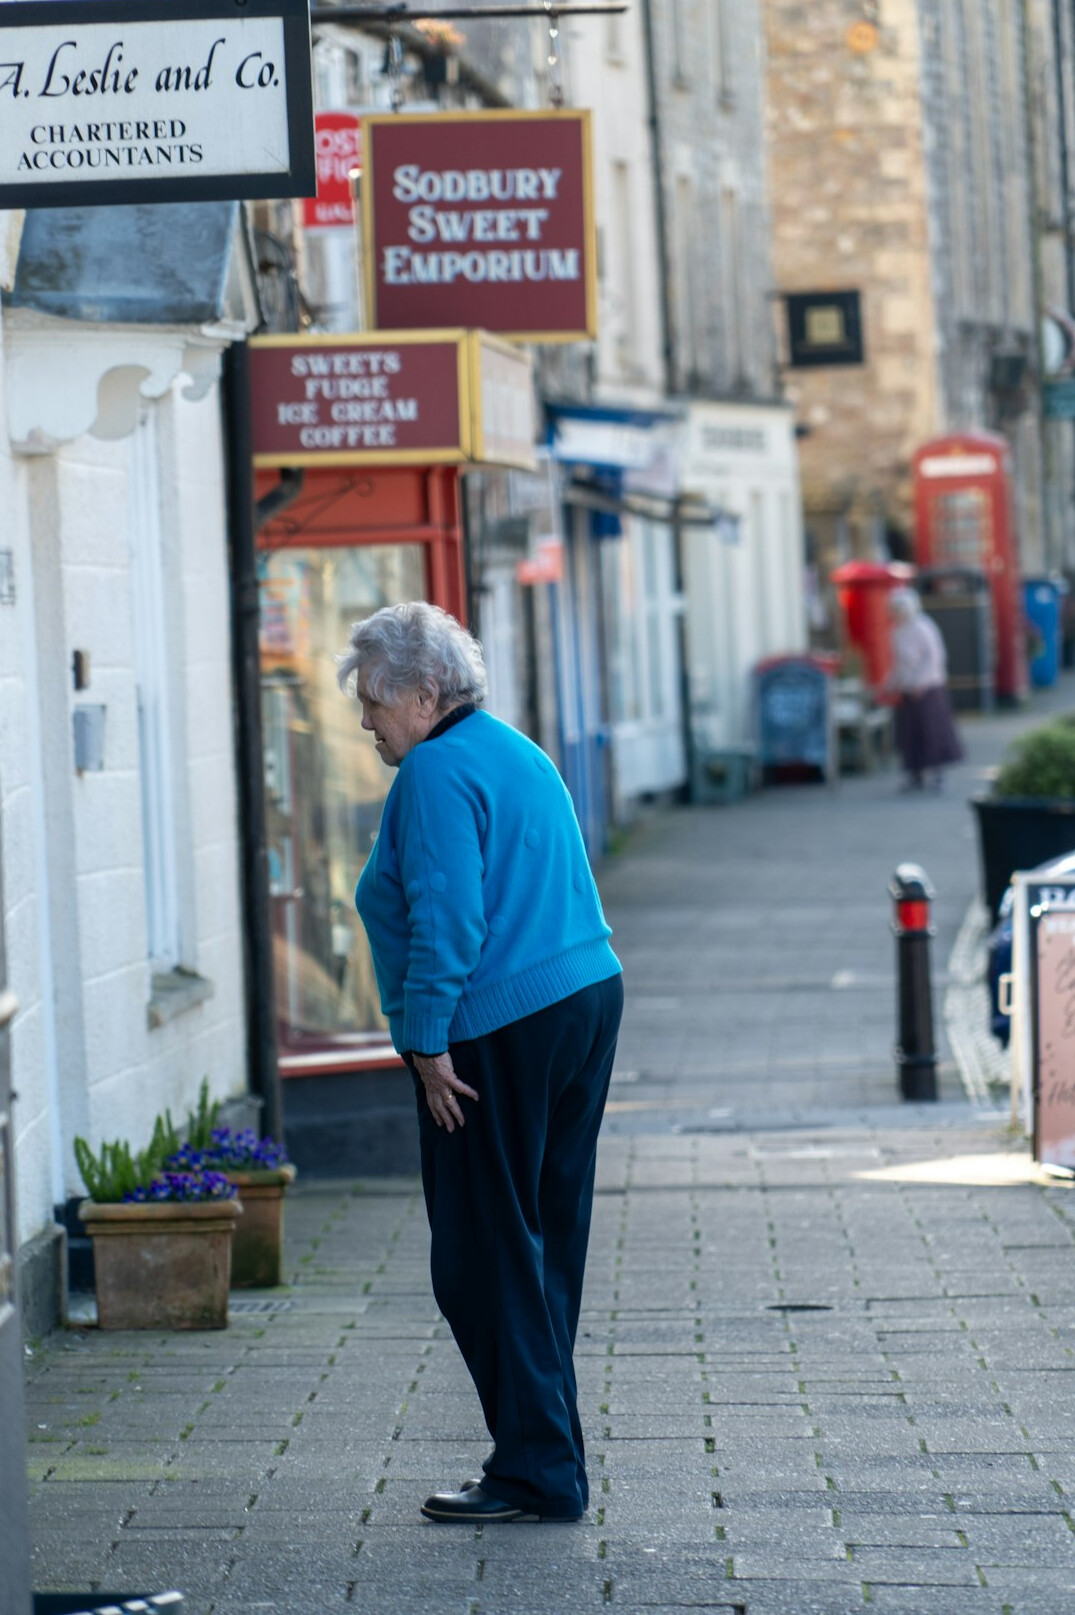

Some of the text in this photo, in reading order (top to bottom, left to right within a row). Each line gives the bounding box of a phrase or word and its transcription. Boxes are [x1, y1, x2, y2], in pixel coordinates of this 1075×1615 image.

[38, 41, 138, 97] Leslie
[155, 38, 226, 92] and
[235, 51, 279, 89] Co.
[30, 119, 187, 144] CHARTERED
[17, 144, 203, 171] ACCOUNTANTS
[393, 164, 561, 202] SODBURY
[408, 204, 548, 243] SWEET
[383, 246, 580, 284] EMPORIUM
[291, 351, 400, 376] SWEETS
[305, 376, 388, 399] FUDGE
[278, 398, 418, 424] ICE CREAM
[300, 424, 396, 447] COFFEE
